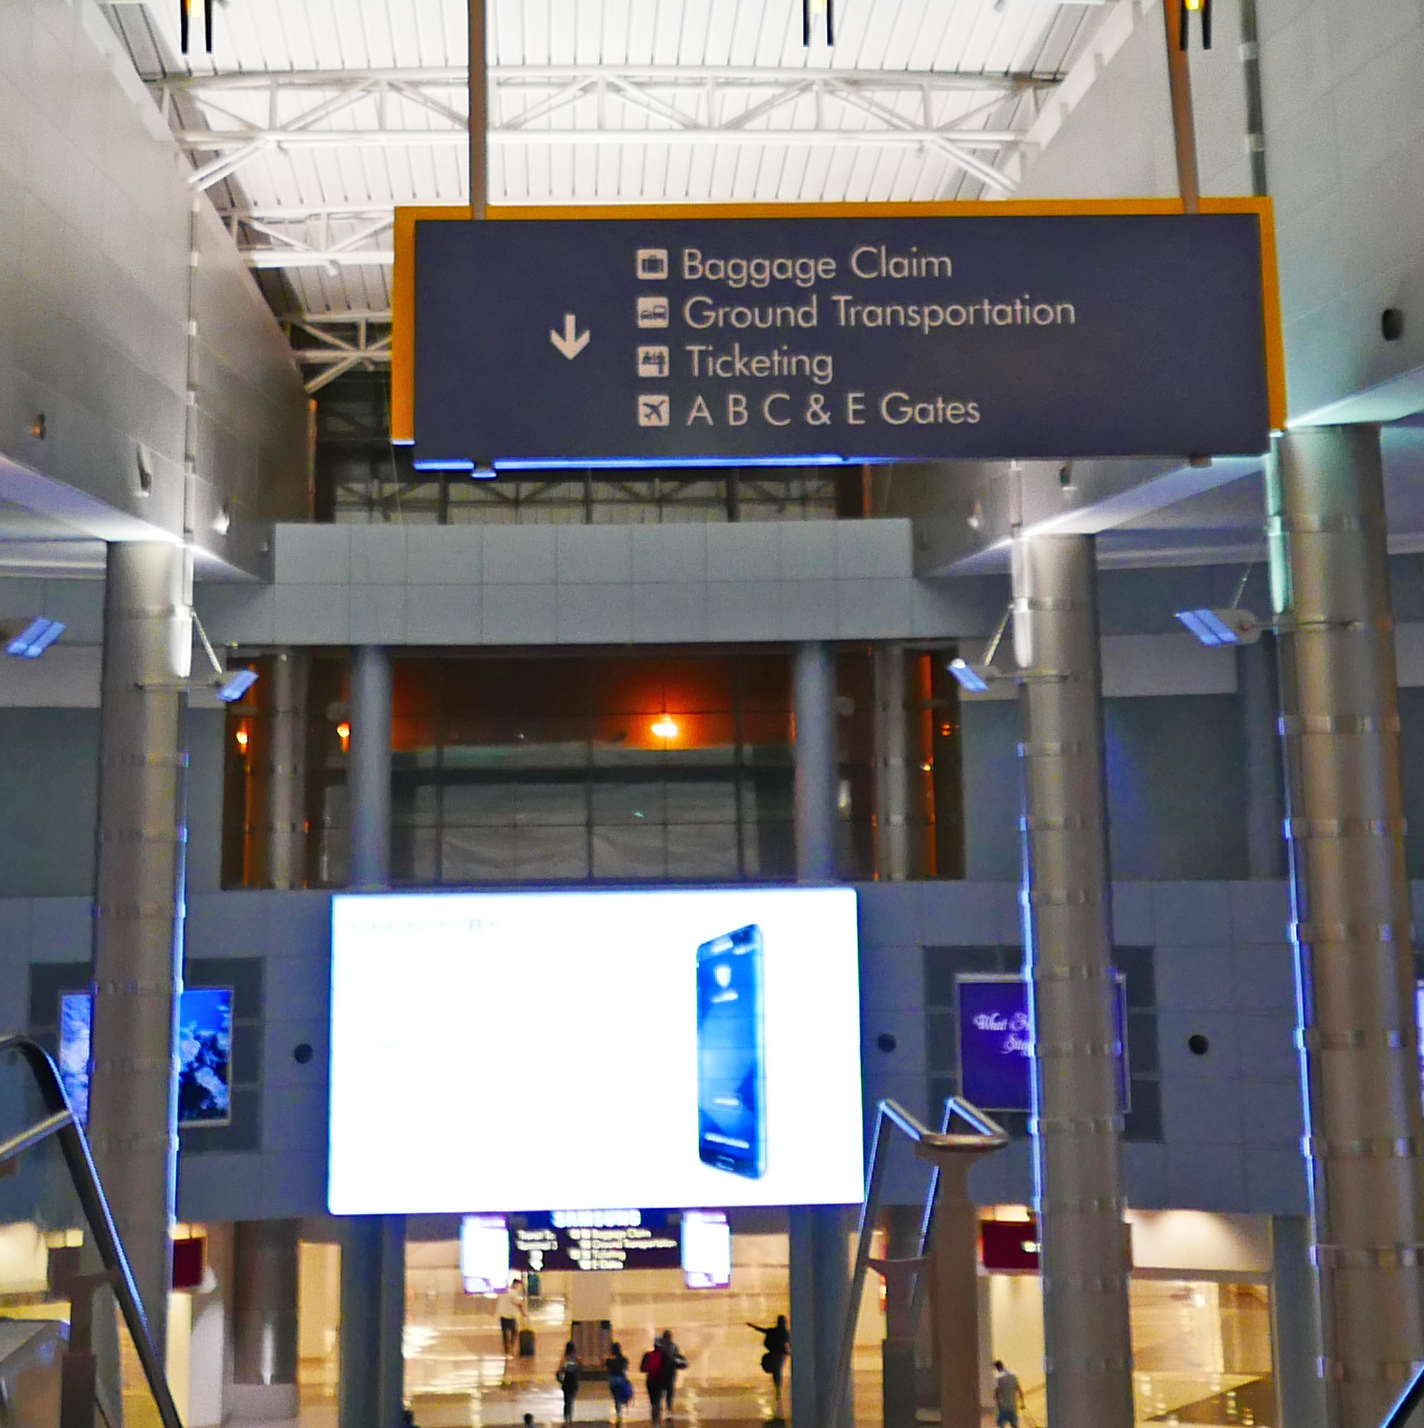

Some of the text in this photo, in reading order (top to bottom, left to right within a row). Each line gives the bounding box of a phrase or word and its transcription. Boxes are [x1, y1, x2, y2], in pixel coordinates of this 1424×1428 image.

[682, 245, 953, 287] Baggage Claim
[683, 294, 1077, 334] Ground Transportation
[685, 343, 834, 385] Ticketing
[686, 391, 982, 426] A B C & E Gates
